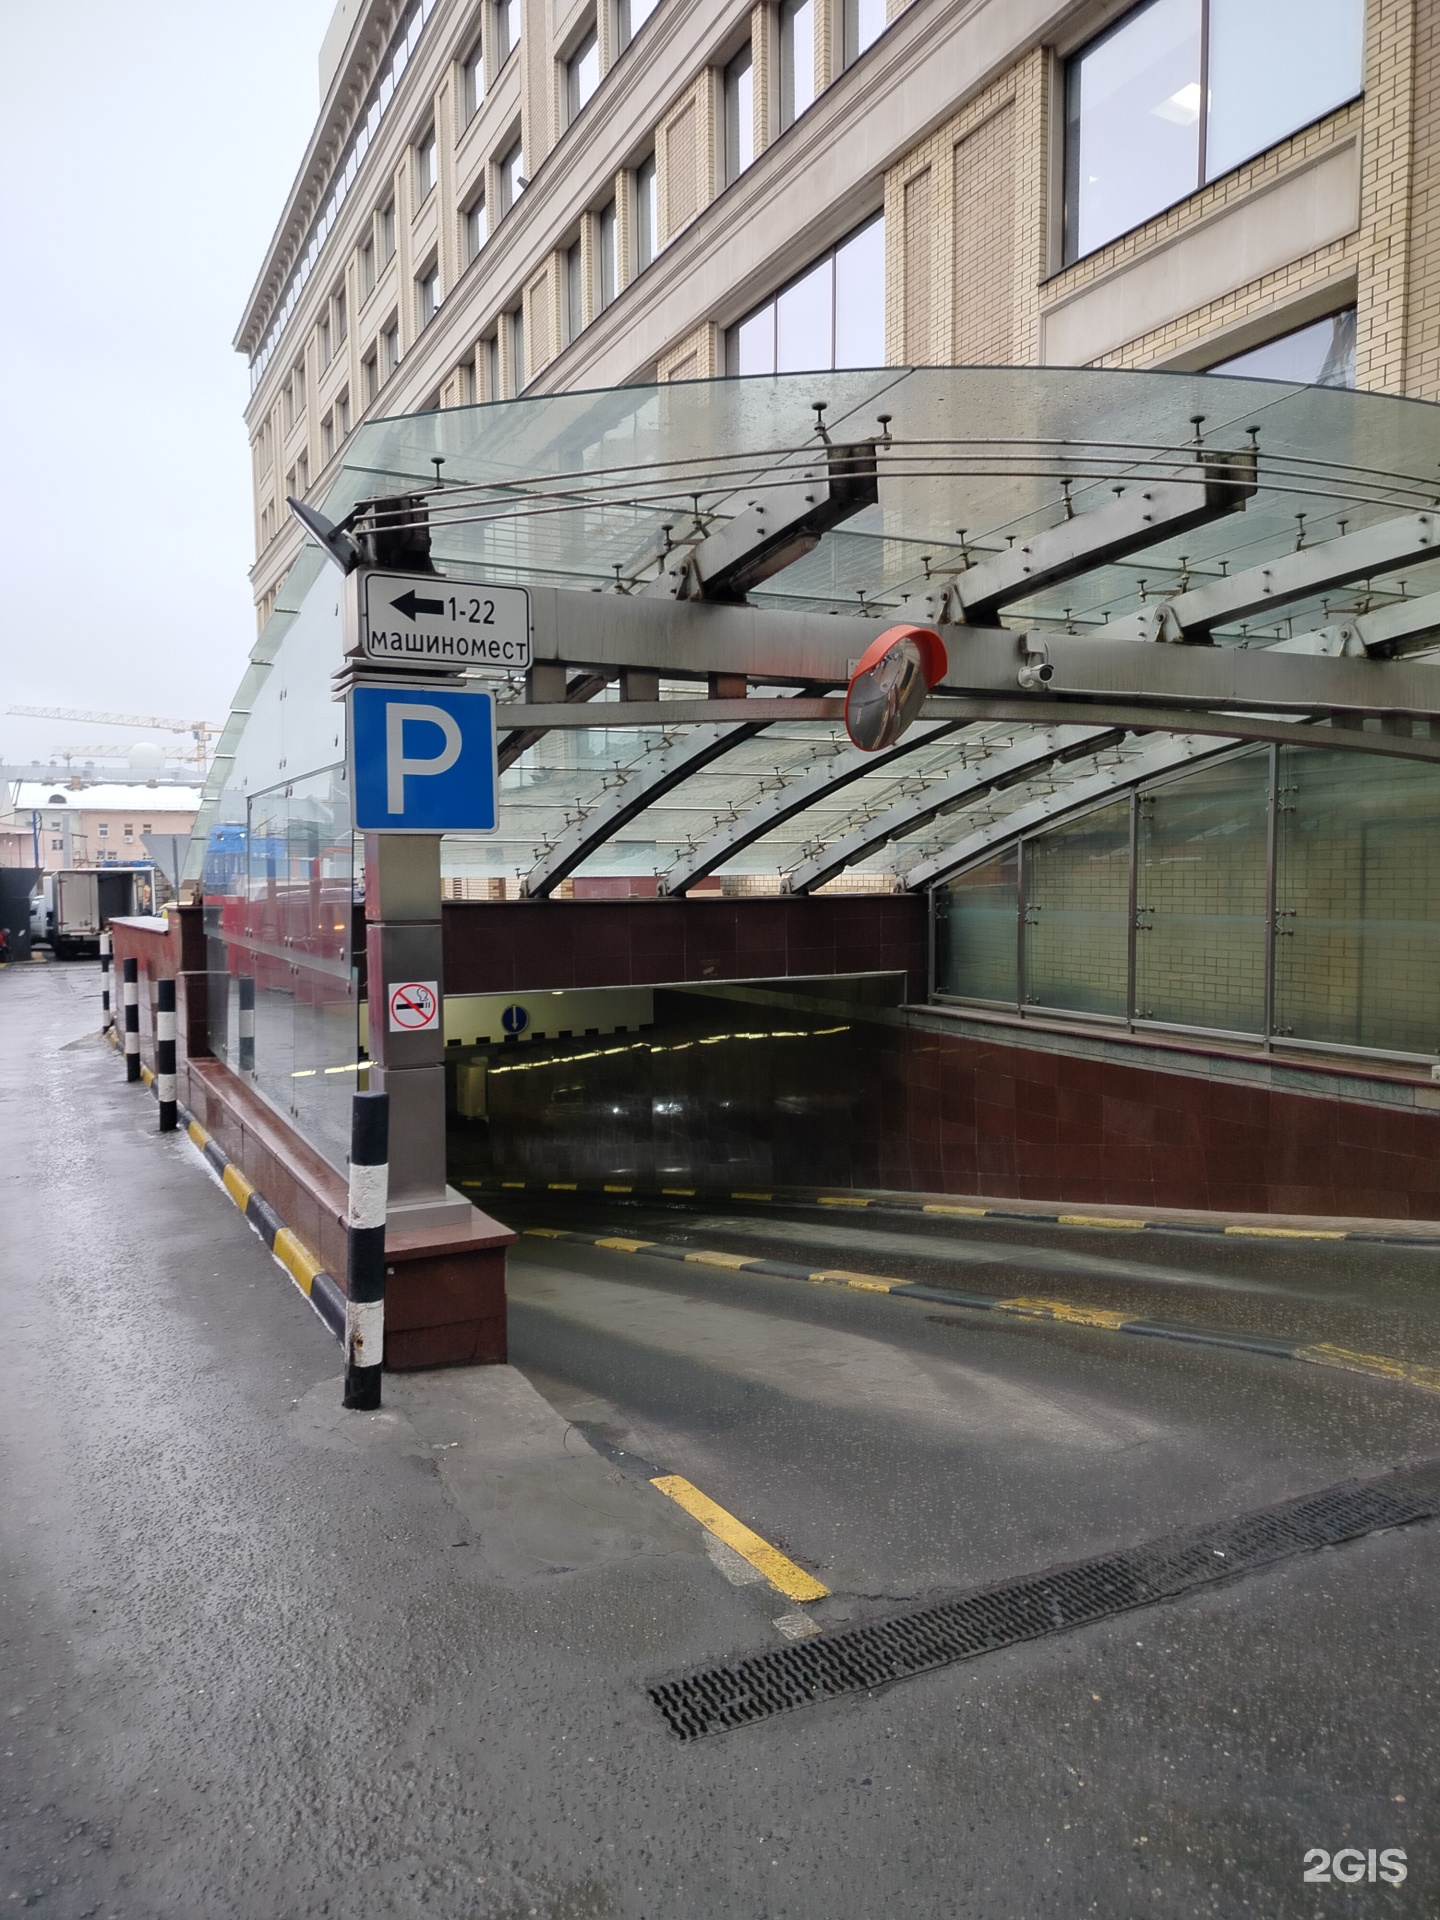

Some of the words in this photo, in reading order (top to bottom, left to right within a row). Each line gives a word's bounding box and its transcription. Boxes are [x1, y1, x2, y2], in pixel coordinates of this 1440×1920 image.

[448, 597, 495, 625] 1-22
[371, 630, 527, 660] машиномест
[385, 702, 463, 815] P
